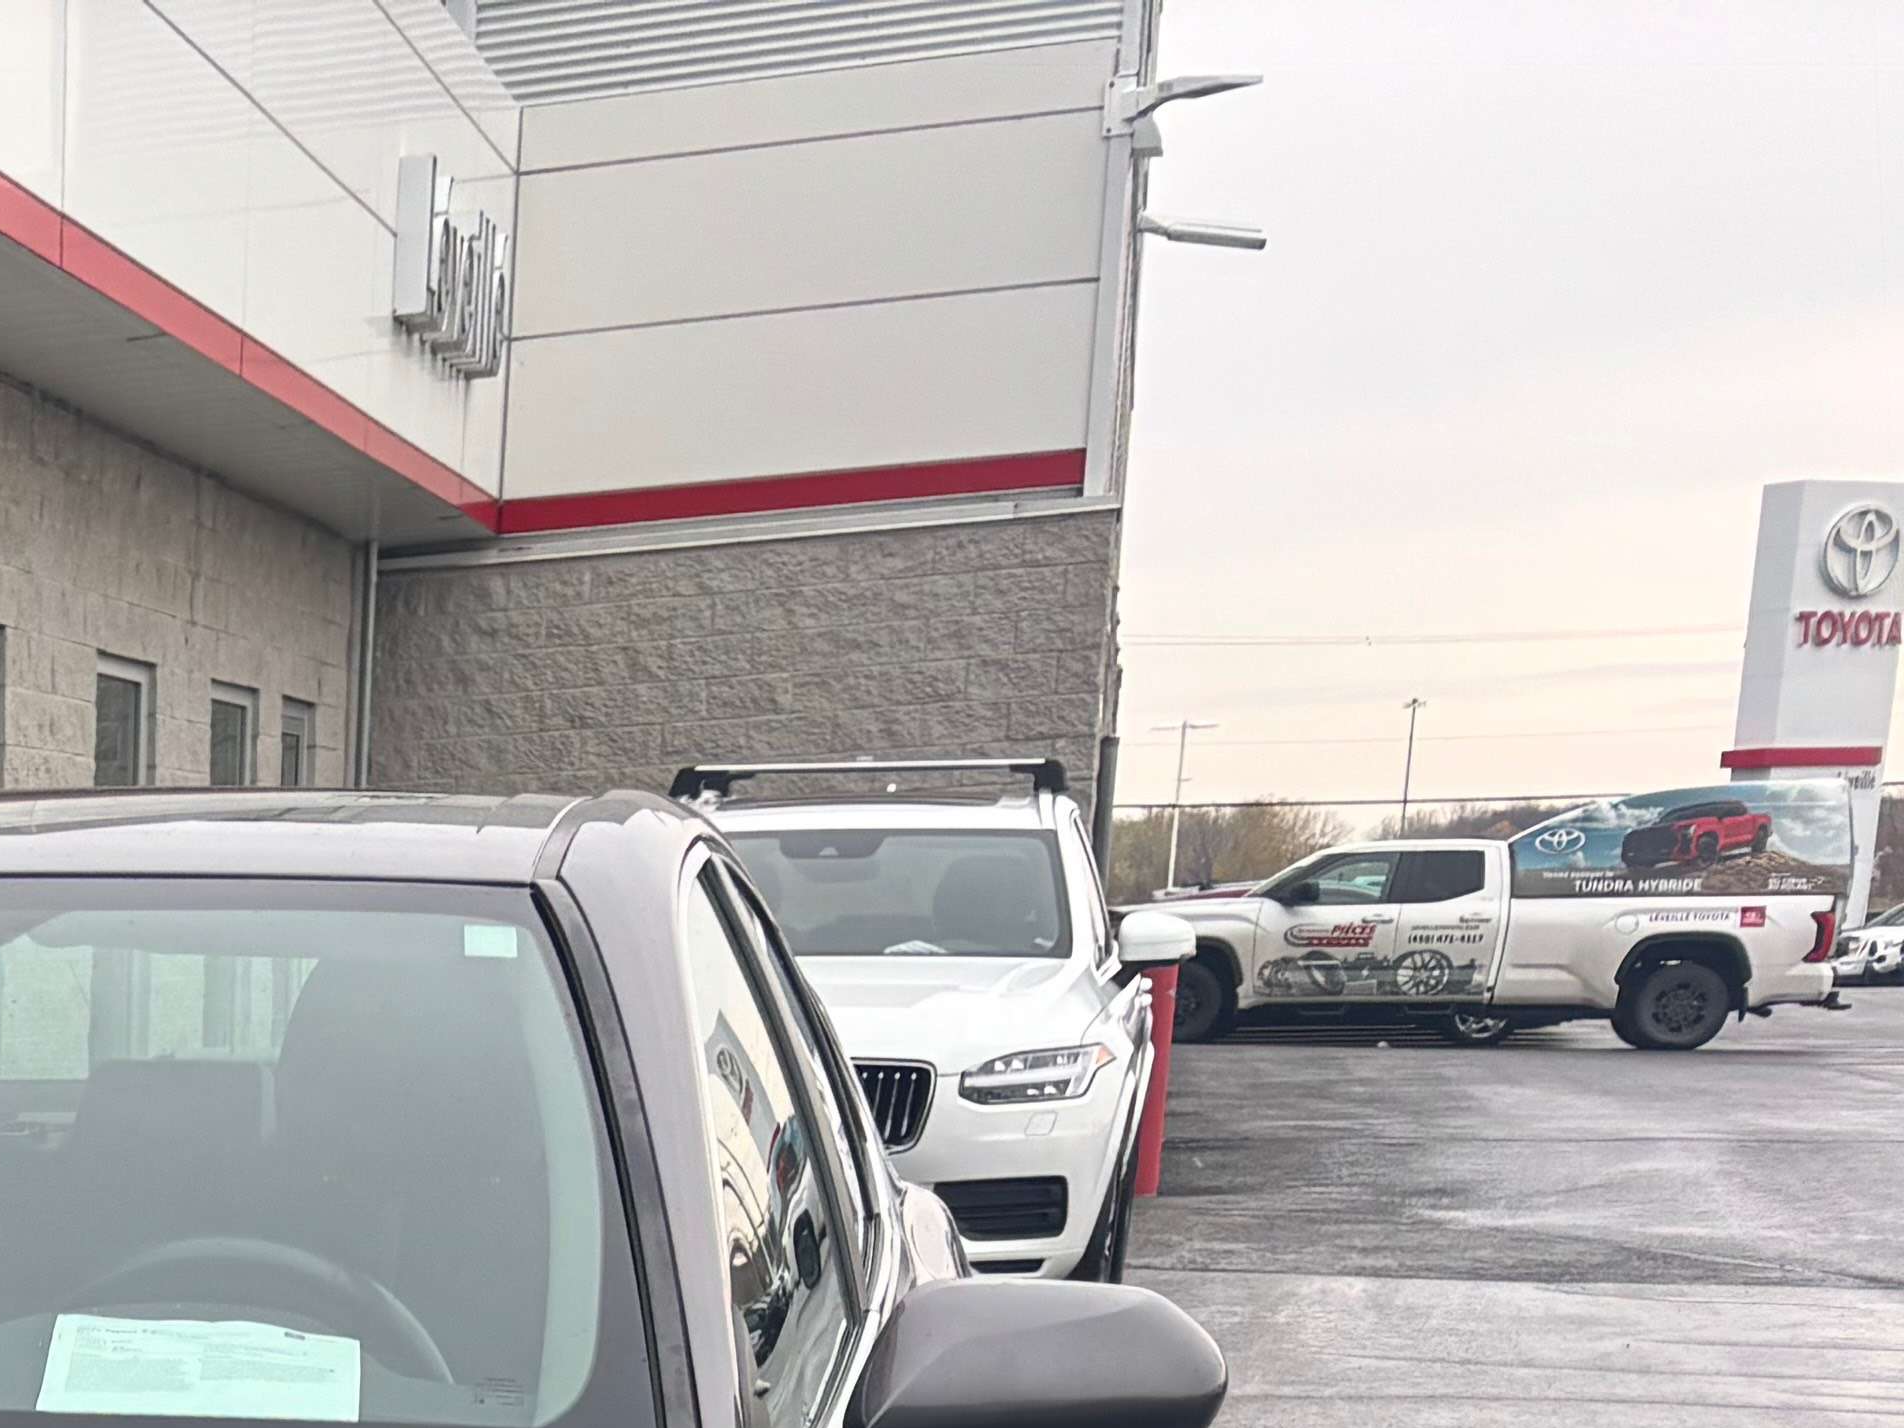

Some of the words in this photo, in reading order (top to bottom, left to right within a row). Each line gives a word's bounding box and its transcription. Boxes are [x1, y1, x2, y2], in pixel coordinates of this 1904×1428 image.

[1795, 609, 1902, 648] TOYOTA
[1575, 879, 1634, 892] TUNDRA
[1637, 878, 1703, 892] HYBRIDE
